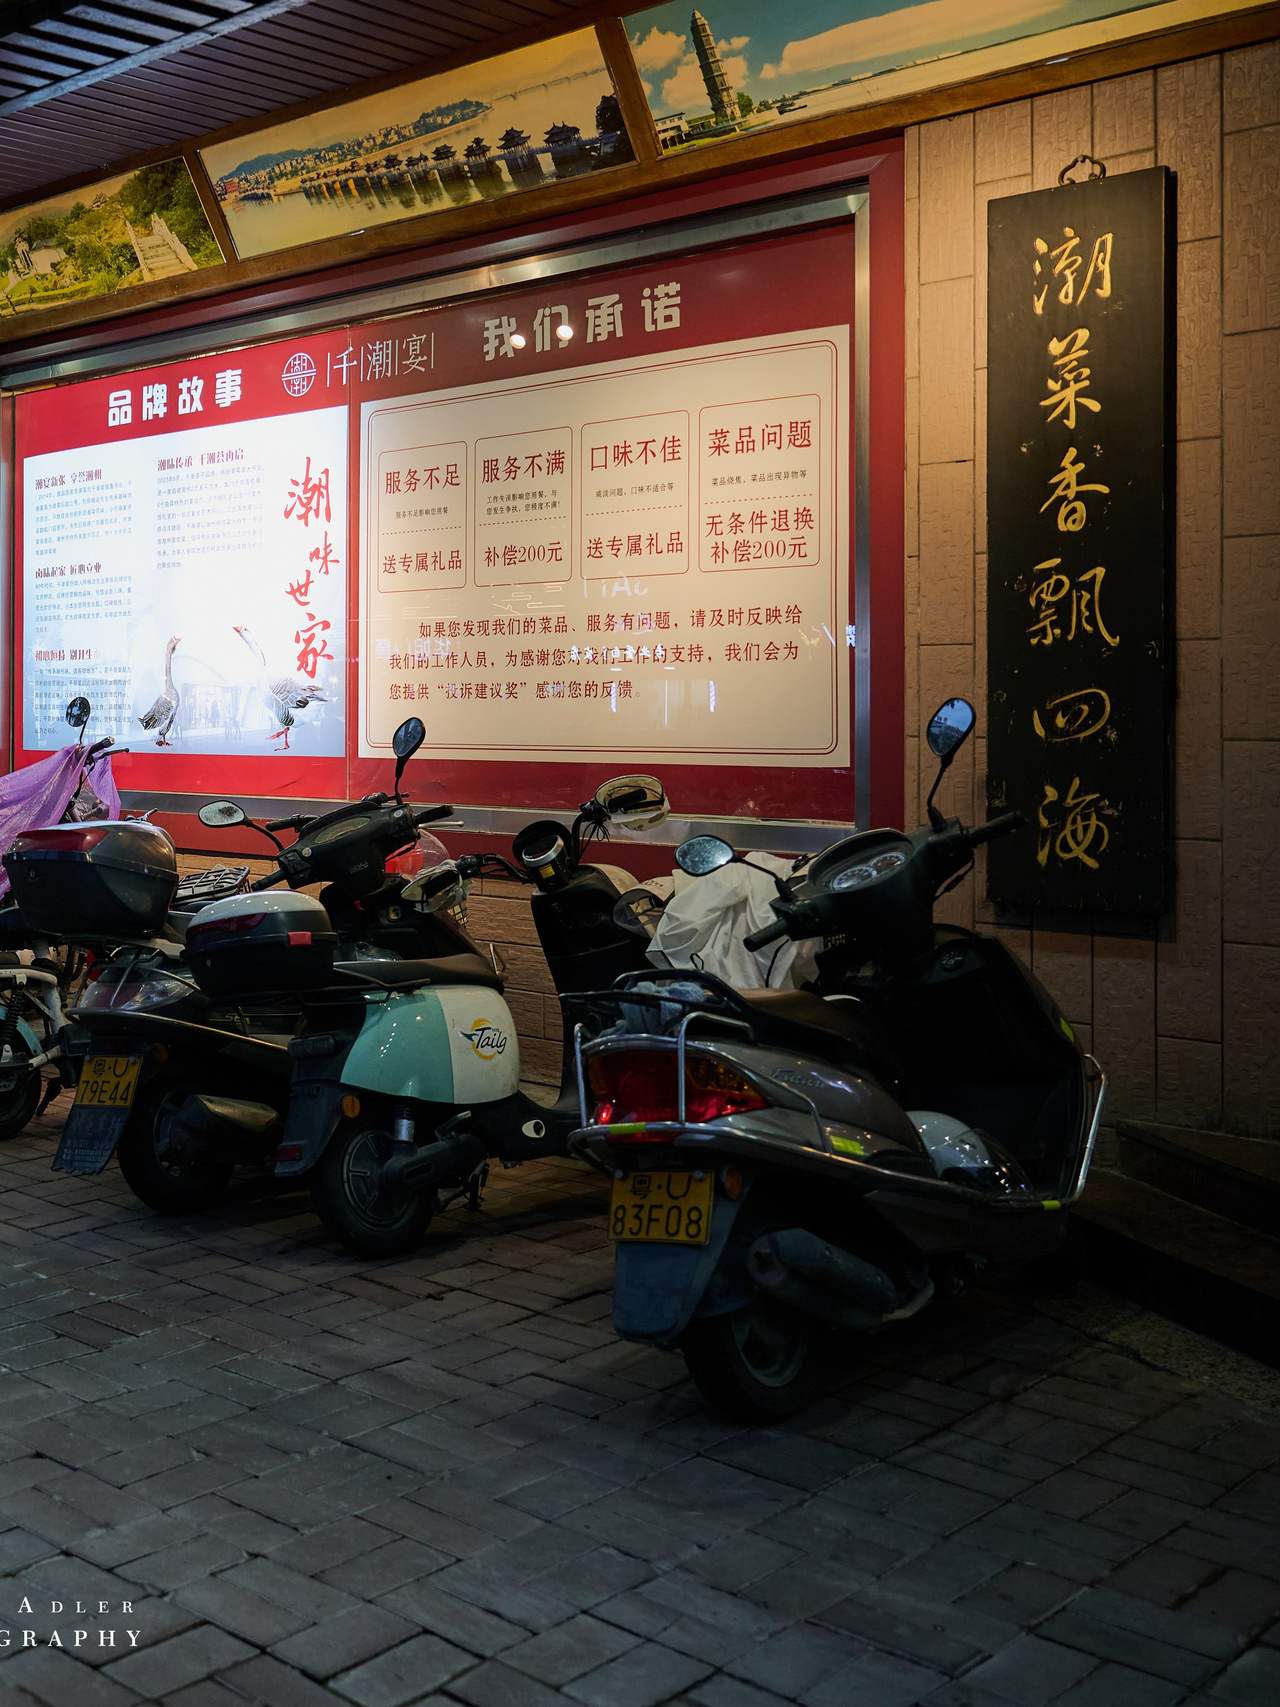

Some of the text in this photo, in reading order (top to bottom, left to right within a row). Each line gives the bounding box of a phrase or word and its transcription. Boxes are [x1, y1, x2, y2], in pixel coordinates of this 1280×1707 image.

[483, 282, 681, 361] 我们承诺
[331, 332, 429, 388] 千潮宴
[108, 368, 243, 427] 品牌故事
[590, 434, 682, 472] 口味不佳
[707, 419, 812, 458] 菜品问题
[384, 463, 461, 495] 服务不足
[482, 449, 566, 484] 服务不满
[395, 507, 448, 519] 服务不足影响您用餐
[705, 506, 815, 538] 无条件退换
[484, 541, 563, 568] 补偿200元
[586, 531, 684, 559] 送专属礼品
[710, 536, 808, 564] 补偿200元
[1026, 226, 1119, 869] 潮菜香飘四海
[283, 456, 340, 679] 潮味世家
[382, 550, 462, 574] 送专属礼品
[418, 604, 803, 639] 如果您发现我们的菜品、服务有问题，请及时反映给
[474, 1026, 508, 1054] Tailg
[80, 1080, 131, 1104] 79E44
[629, 1173, 692, 1200] 粤·U
[612, 1204, 703, 1239] 83F08
